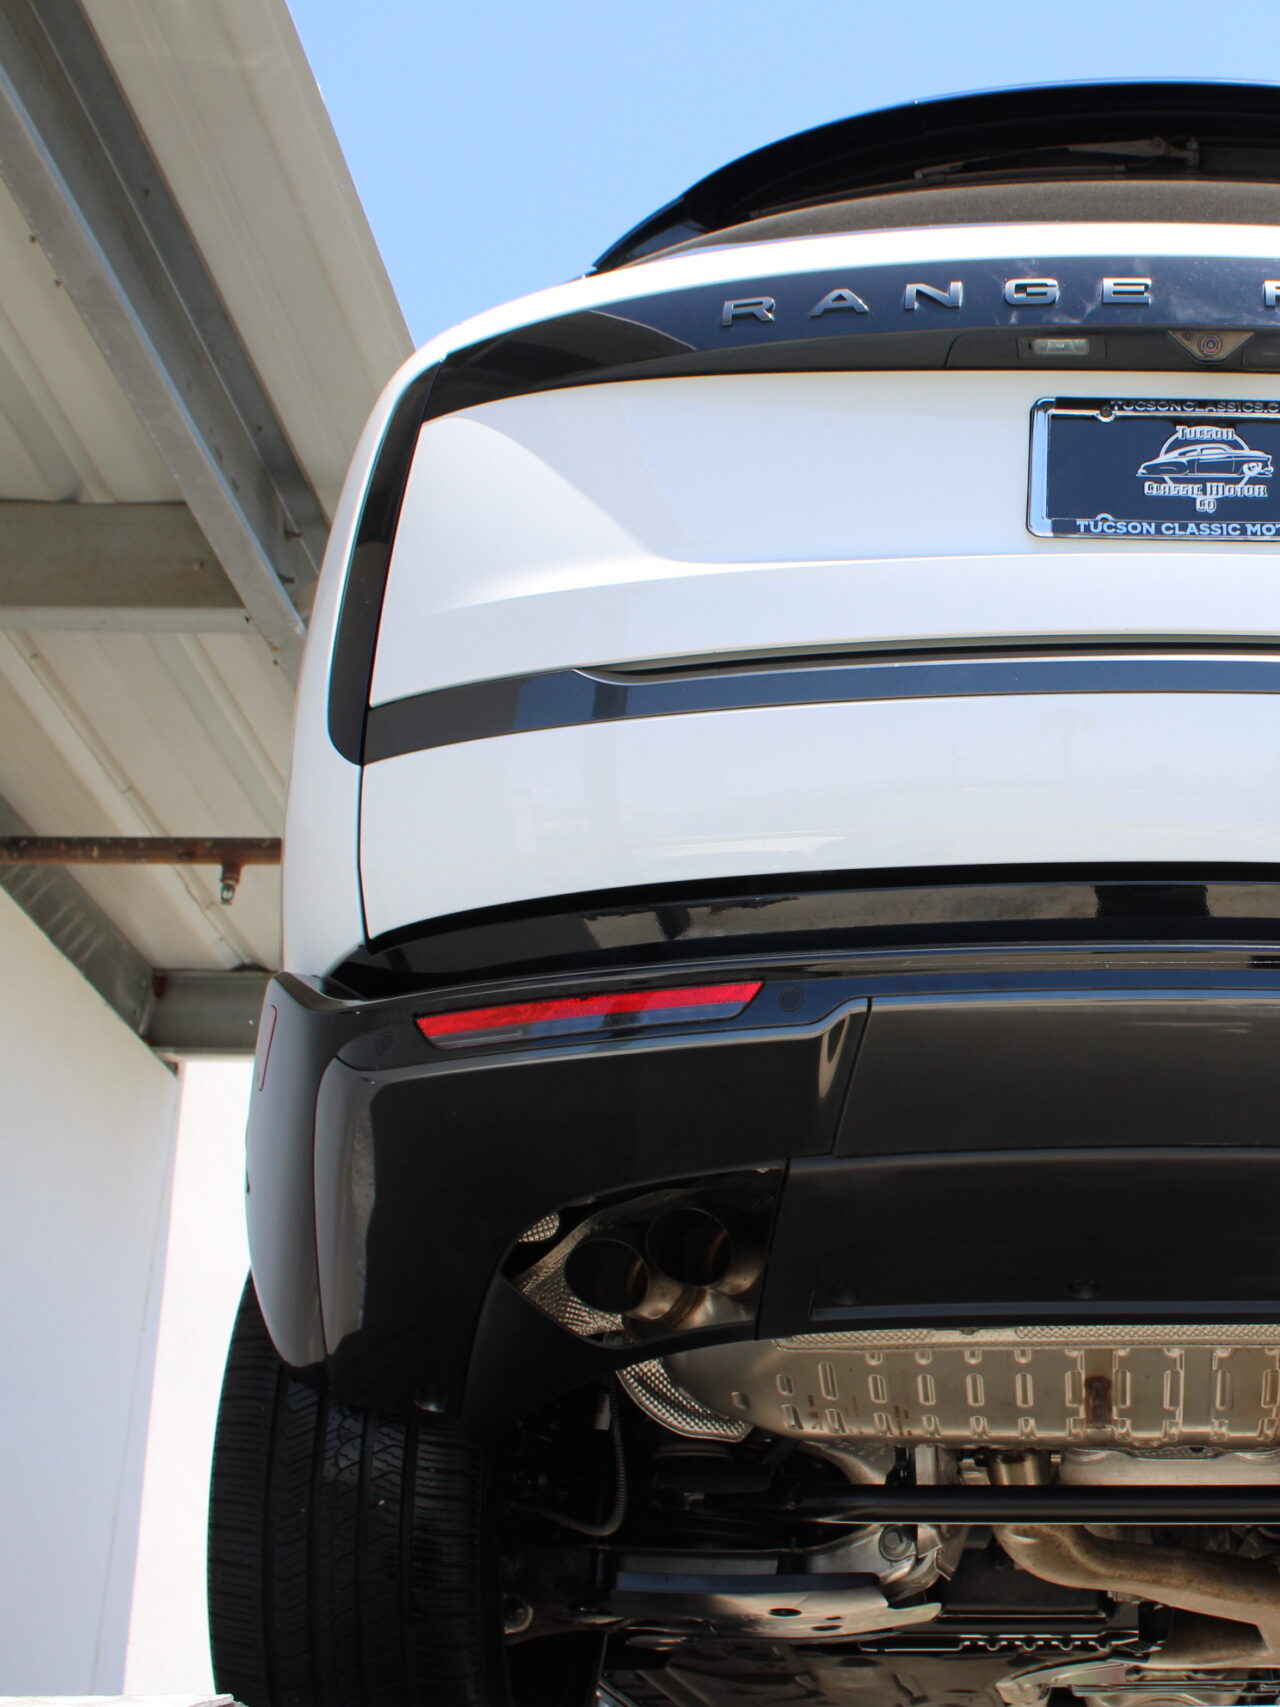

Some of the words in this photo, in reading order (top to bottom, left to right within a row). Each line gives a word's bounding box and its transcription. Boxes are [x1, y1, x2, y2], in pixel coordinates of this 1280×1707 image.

[721, 277, 1152, 326] RANGE
[1076, 519, 1155, 535] TUCSON
[1161, 521, 1241, 536] CLASSIC
